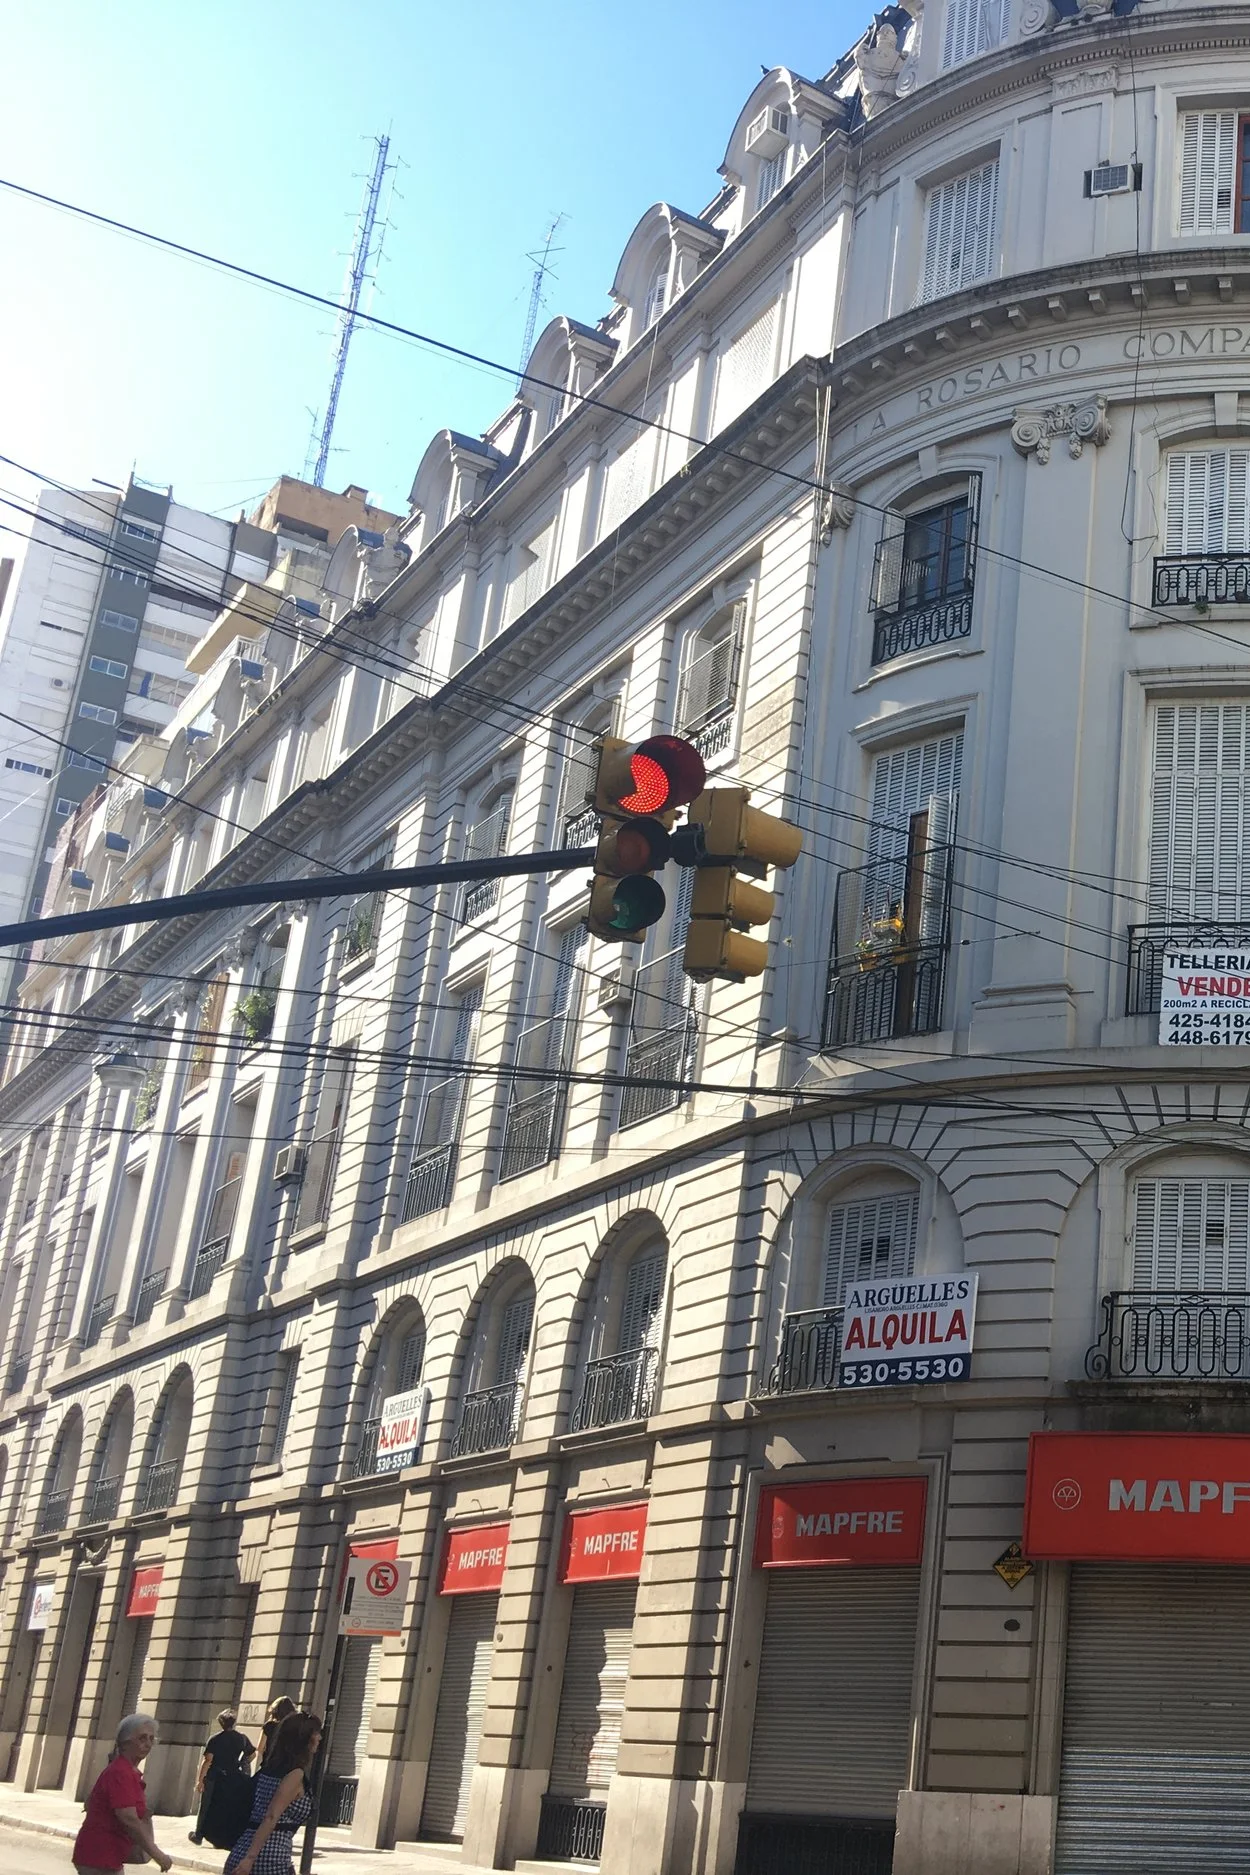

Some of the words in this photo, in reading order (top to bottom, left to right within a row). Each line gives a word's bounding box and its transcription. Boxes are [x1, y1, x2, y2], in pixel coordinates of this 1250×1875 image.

[915, 344, 1082, 414] ROSARIO
[1163, 1000, 1197, 1009] 200m2
[1200, 1000, 1208, 1008] A
[847, 1280, 970, 1310] ARGÜELLES
[844, 1309, 968, 1351] ALQUILA
[843, 1357, 964, 1385] 530-5530
[378, 1417, 418, 1450] ALQUILA
[376, 1451, 413, 1473] 530-5530
[795, 1511, 904, 1537] MAPFRE
[584, 1530, 639, 1556] MAPFRE
[458, 1547, 504, 1572] MAPFRE
